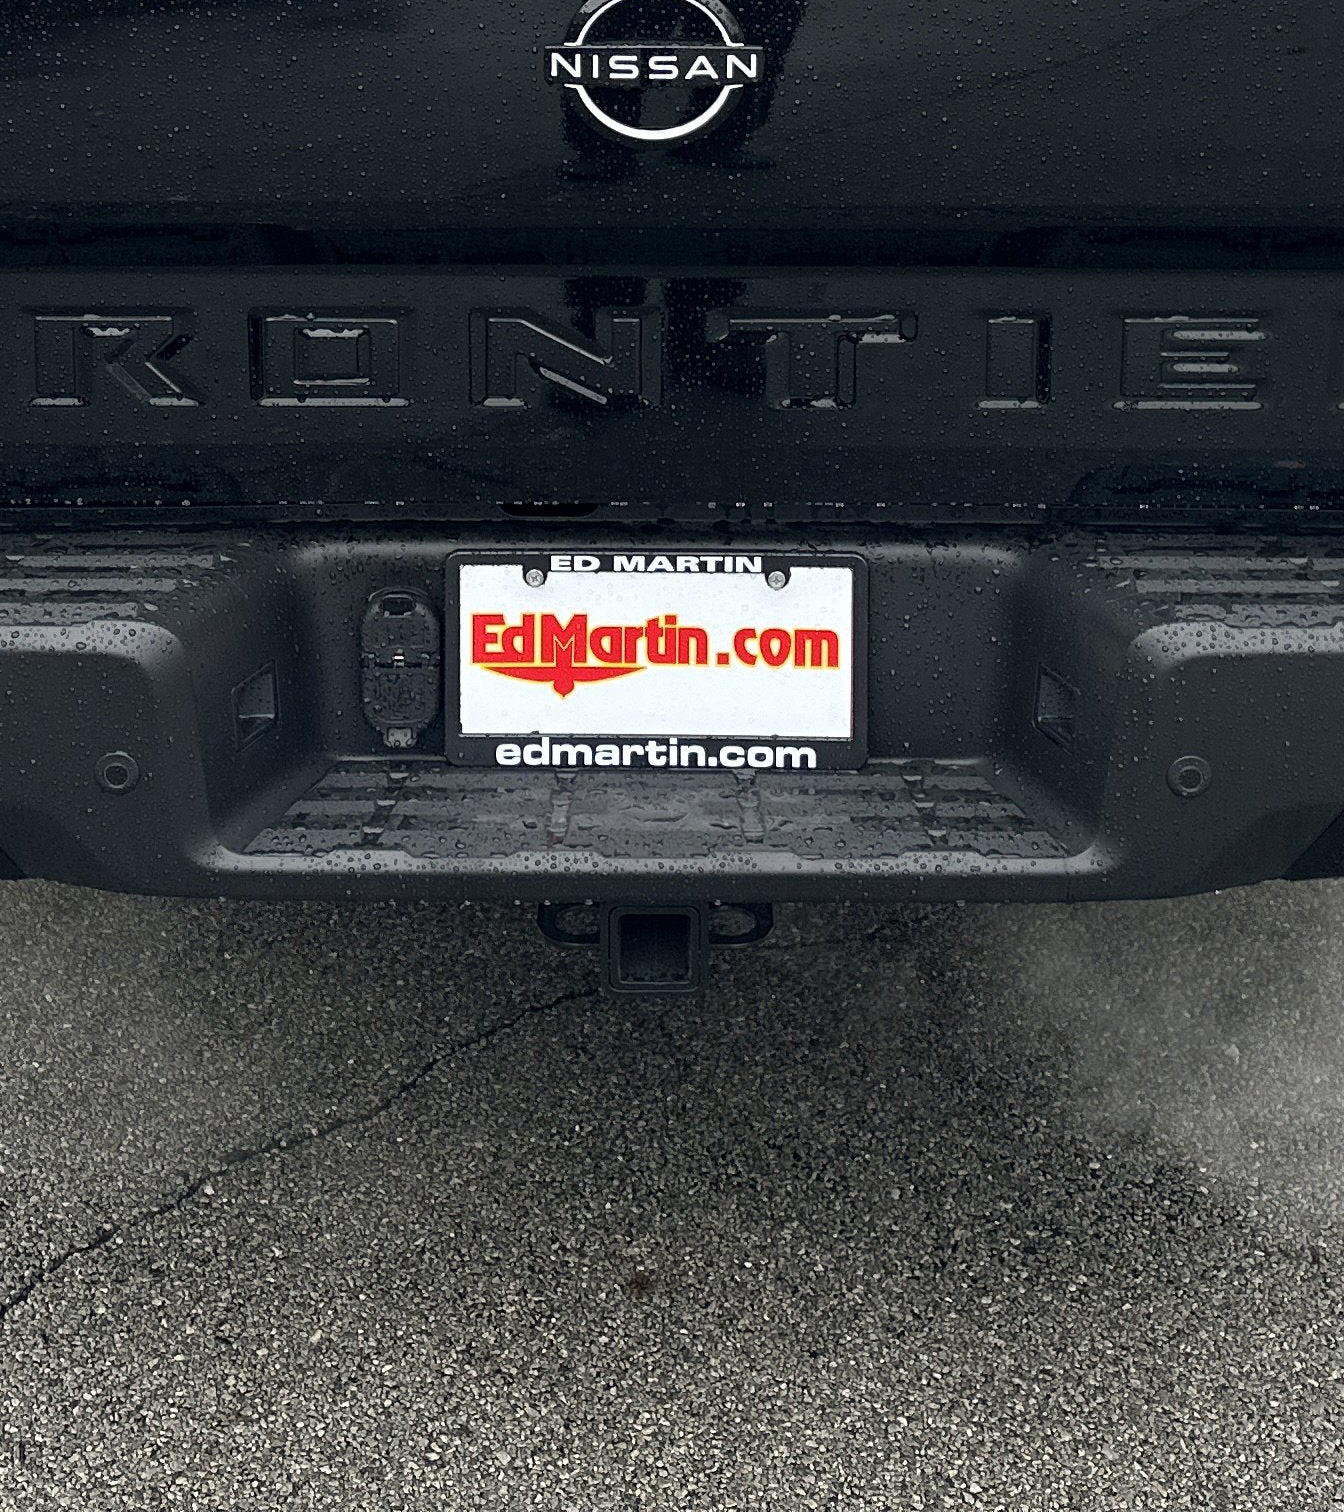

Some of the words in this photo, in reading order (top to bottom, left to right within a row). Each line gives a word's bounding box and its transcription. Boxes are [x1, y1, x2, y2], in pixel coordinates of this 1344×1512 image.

[550, 51, 757, 81] NISSAN
[549, 554, 601, 572] ED
[612, 555, 763, 573] MARTIN
[494, 736, 818, 769] edmartin.com
